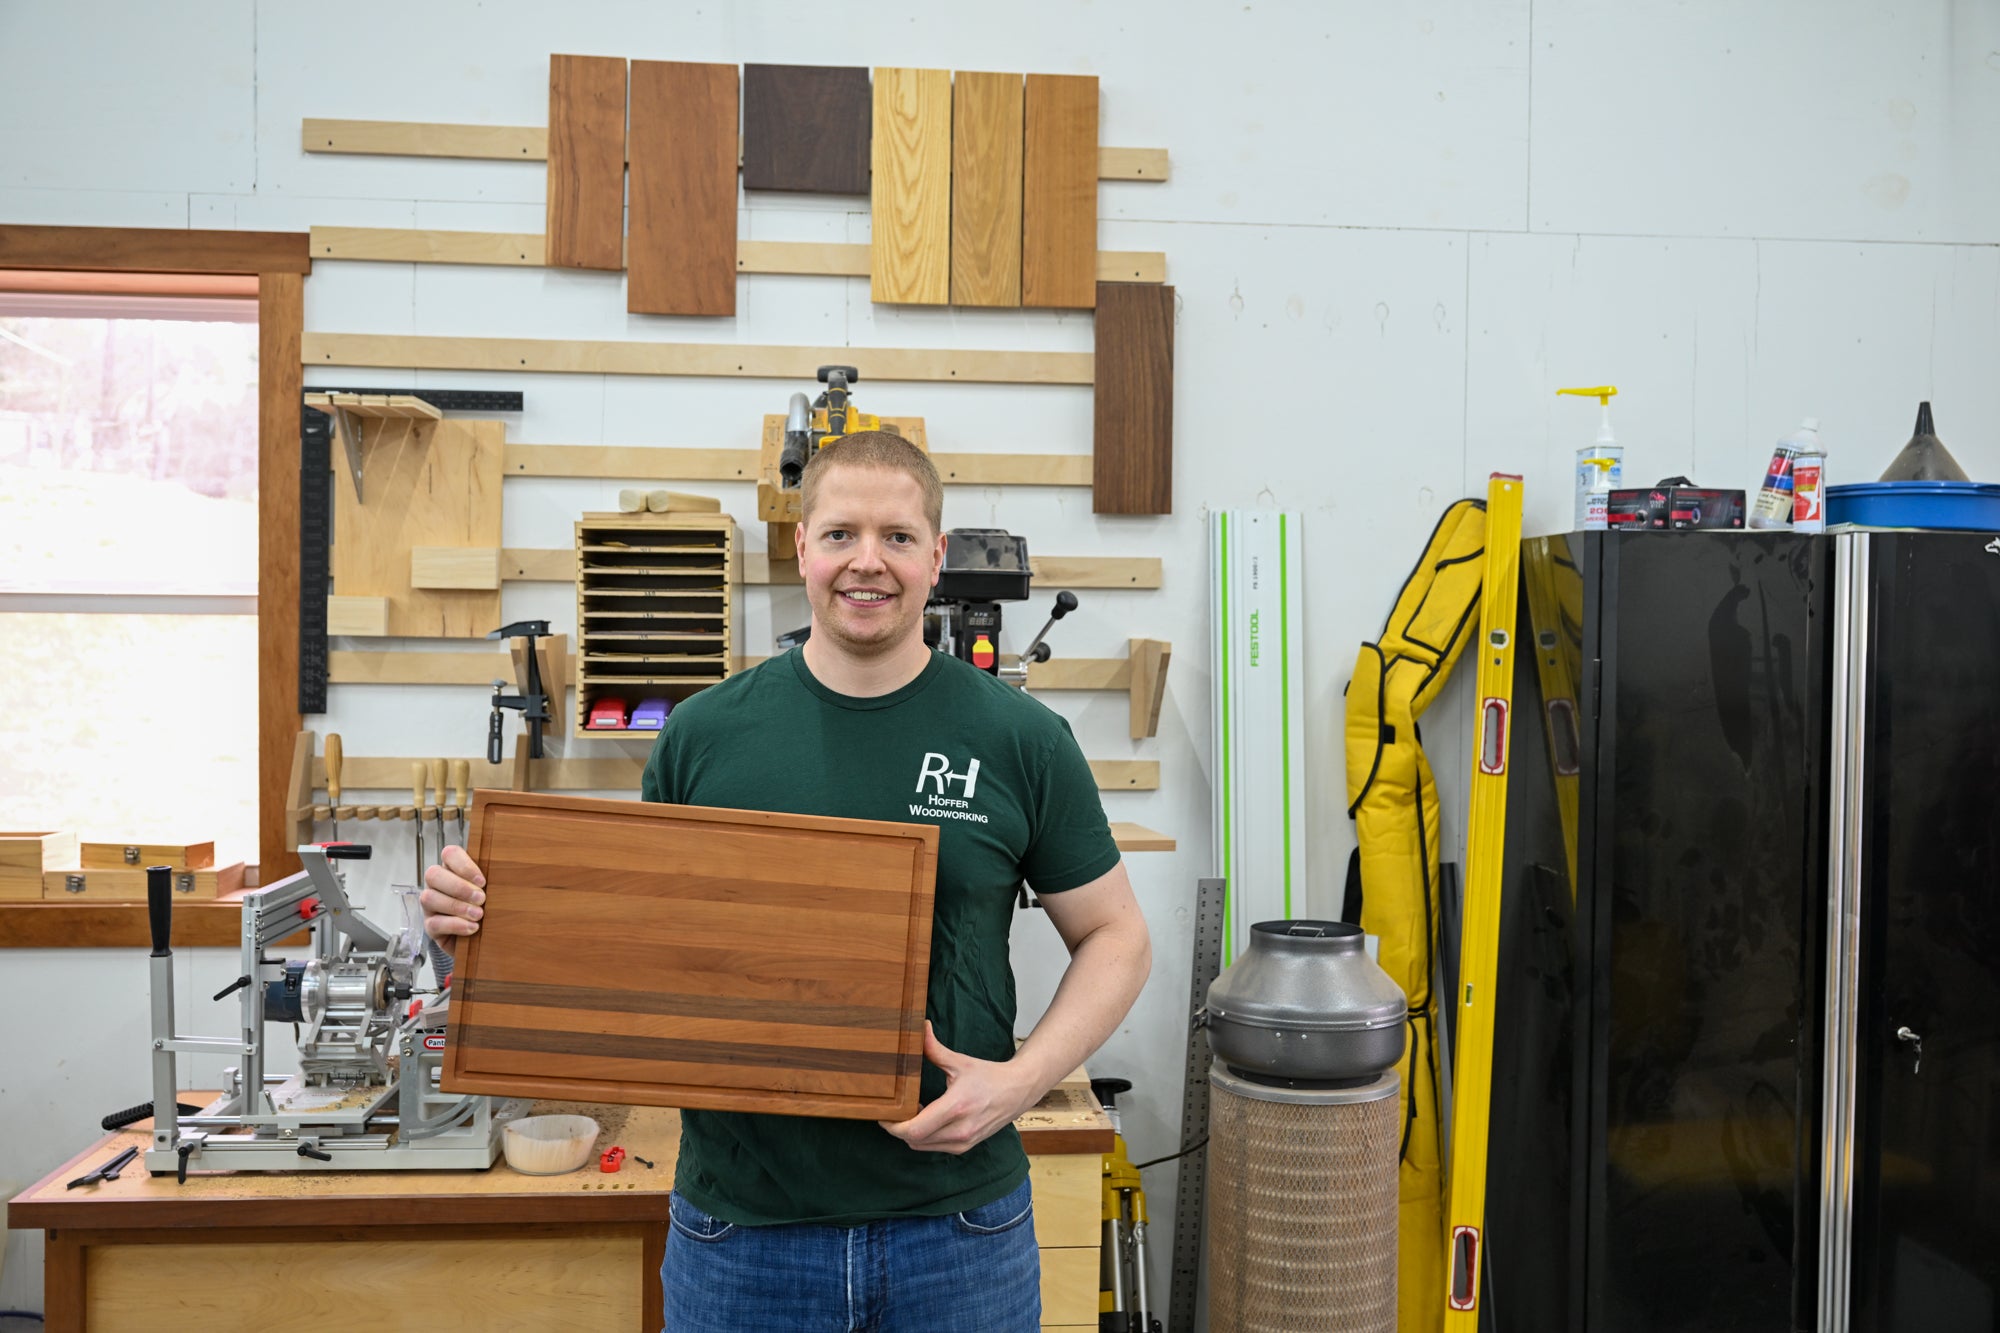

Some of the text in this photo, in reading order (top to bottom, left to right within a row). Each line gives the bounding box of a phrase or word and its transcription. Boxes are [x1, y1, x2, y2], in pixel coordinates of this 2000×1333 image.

[1250, 608, 1259, 667] FESTOOL
[928, 794, 969, 809] HOFFER
[909, 804, 989, 824] WOODWORKING
[428, 1039, 445, 1047] Pant
